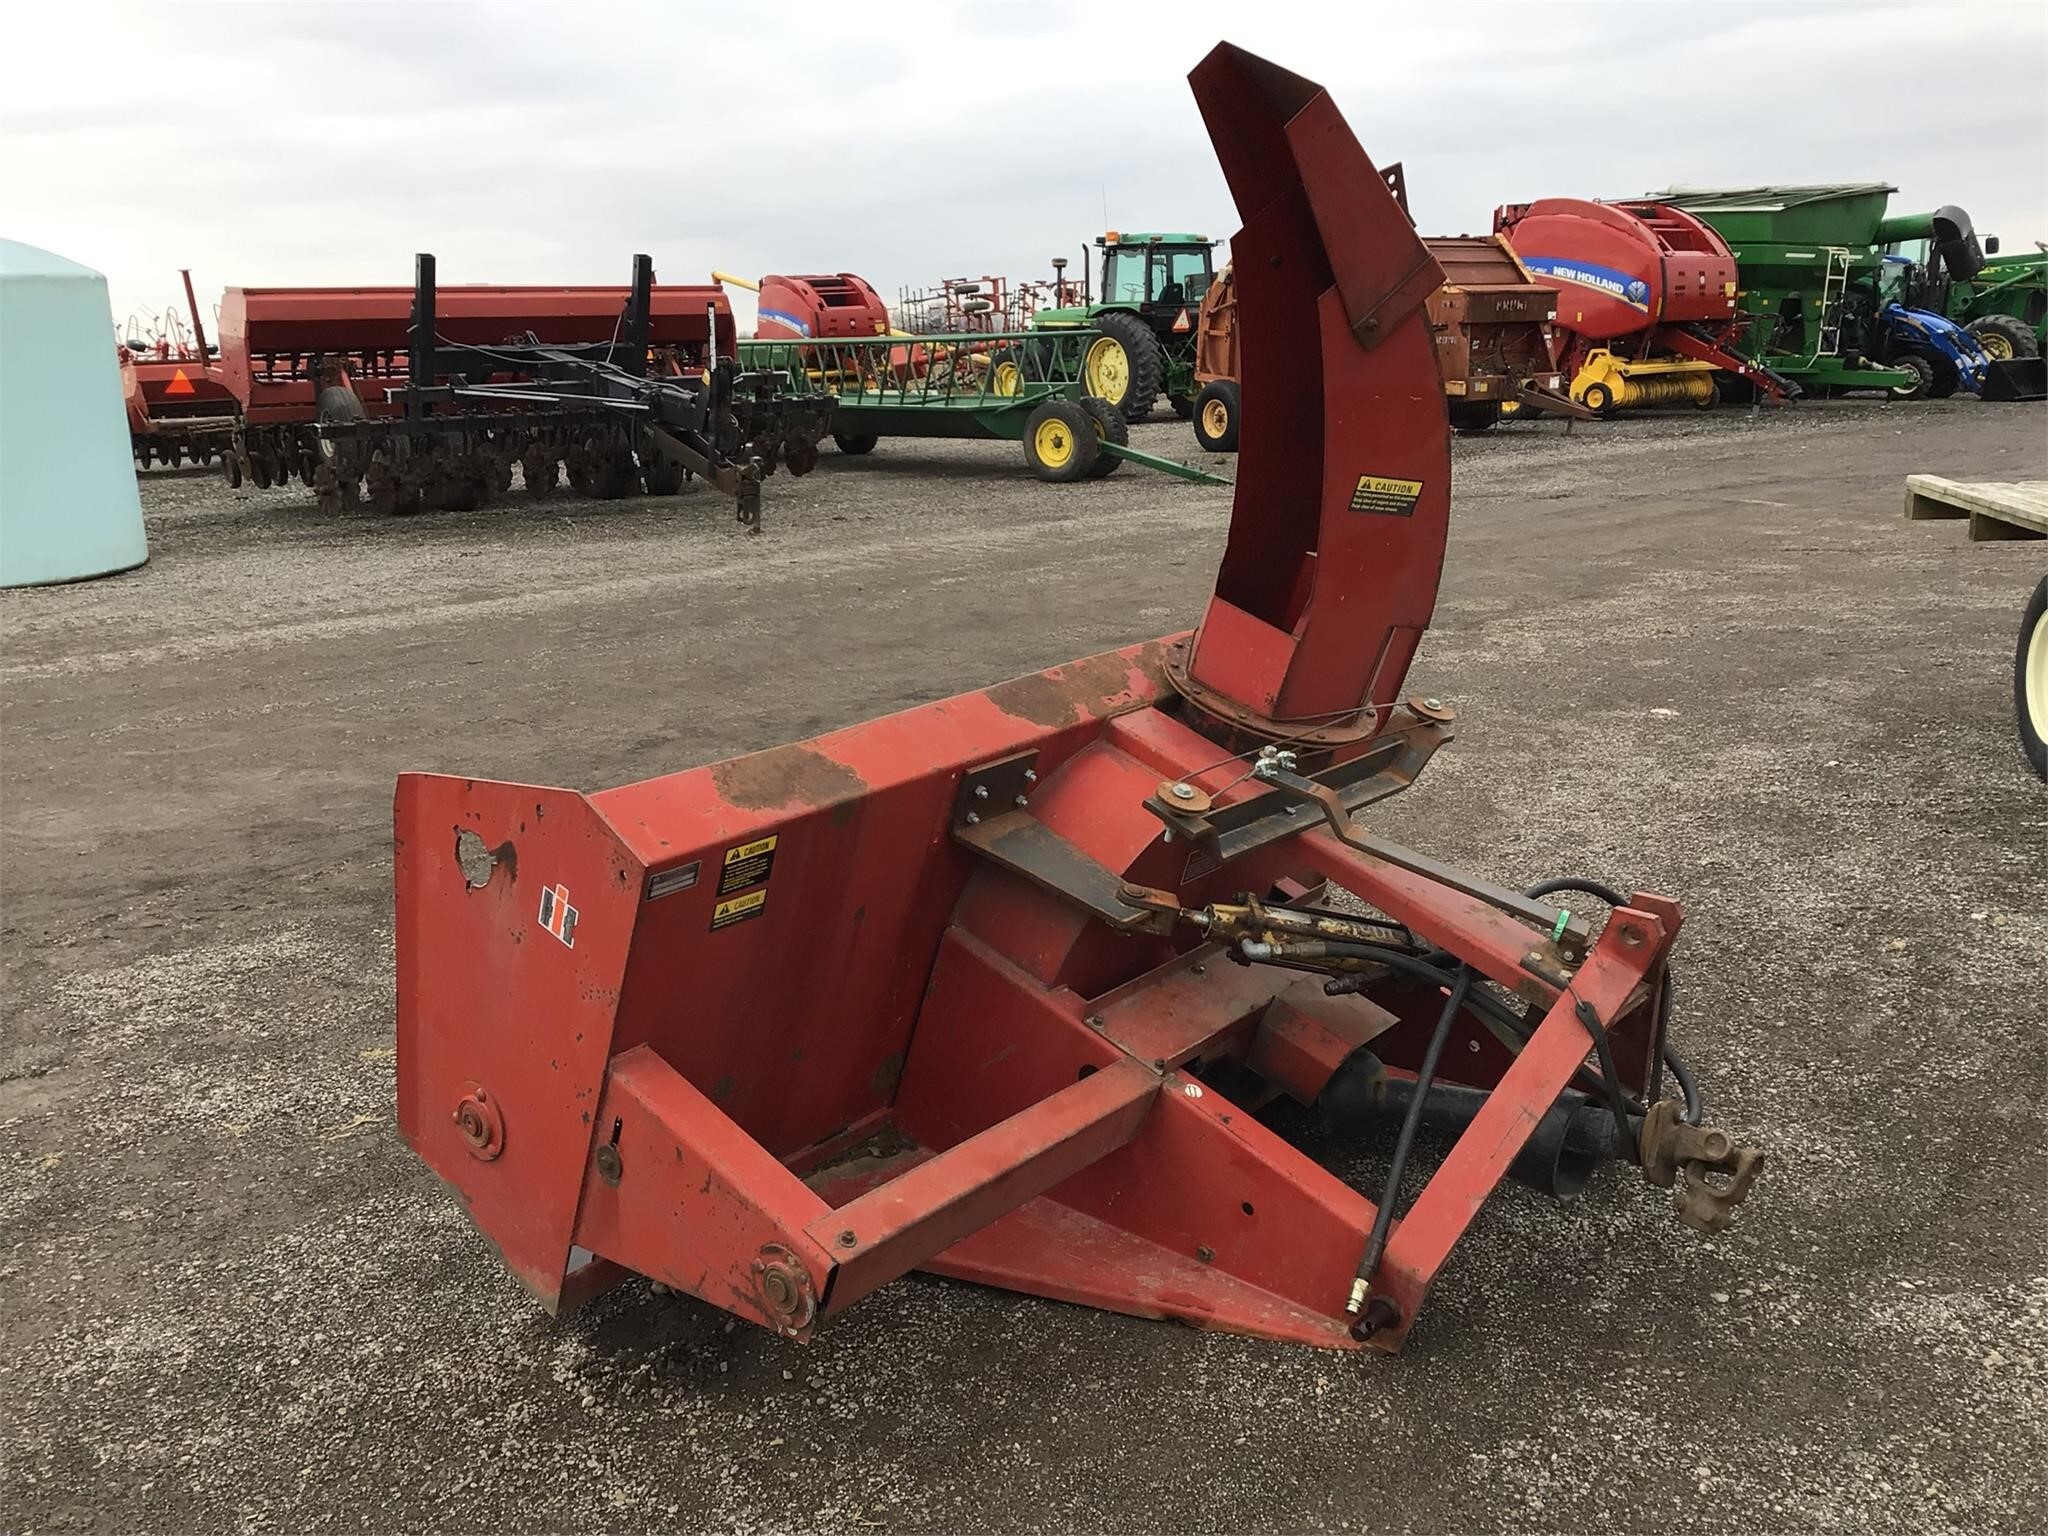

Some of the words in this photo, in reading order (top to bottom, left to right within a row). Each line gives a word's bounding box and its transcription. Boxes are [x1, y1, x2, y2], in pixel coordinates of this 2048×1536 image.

[1553, 266, 1576, 279] NEW
[1577, 271, 1624, 293] HOLLAND
[1374, 482, 1414, 493] CAUTION
